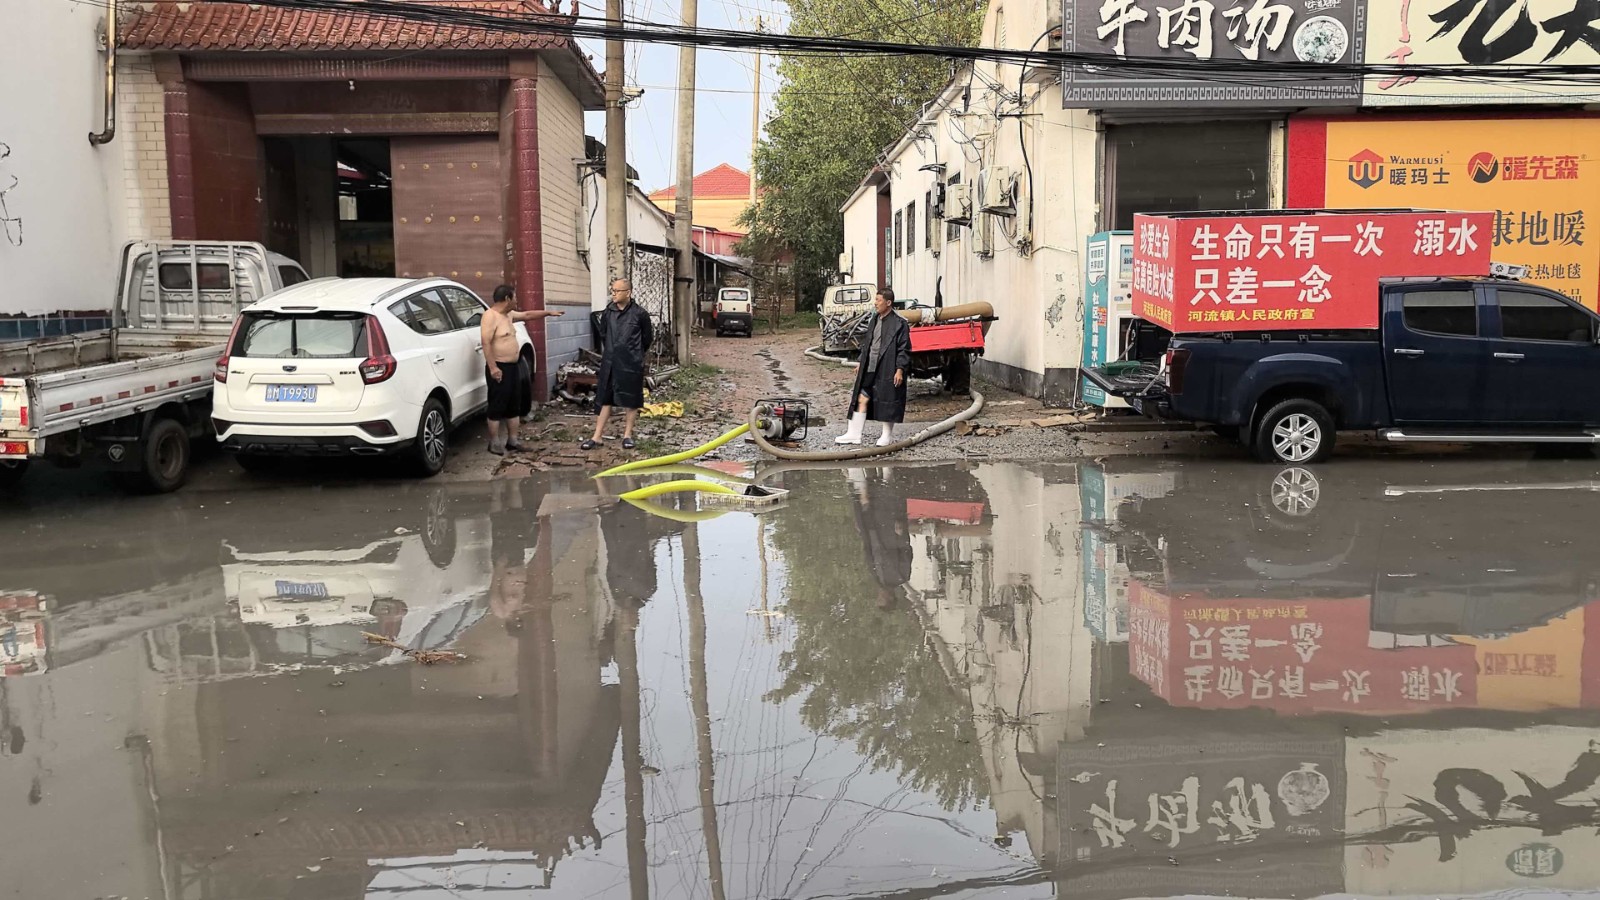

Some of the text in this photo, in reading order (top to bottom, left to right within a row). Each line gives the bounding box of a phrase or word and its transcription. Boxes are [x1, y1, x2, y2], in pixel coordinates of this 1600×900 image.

[1096, 0, 1295, 60] 牛肉汤
[1390, 168, 1450, 185] 暖玛士
[1502, 155, 1579, 181] 暖先森
[1140, 222, 1170, 261] 珍爱生命
[1190, 218, 1478, 261] 生命只有一次 溺水
[1133, 258, 1174, 303] 远离危险水域
[1190, 264, 1333, 305] 只差一念
[1188, 308, 1315, 322] 河流镇人民政府宣
